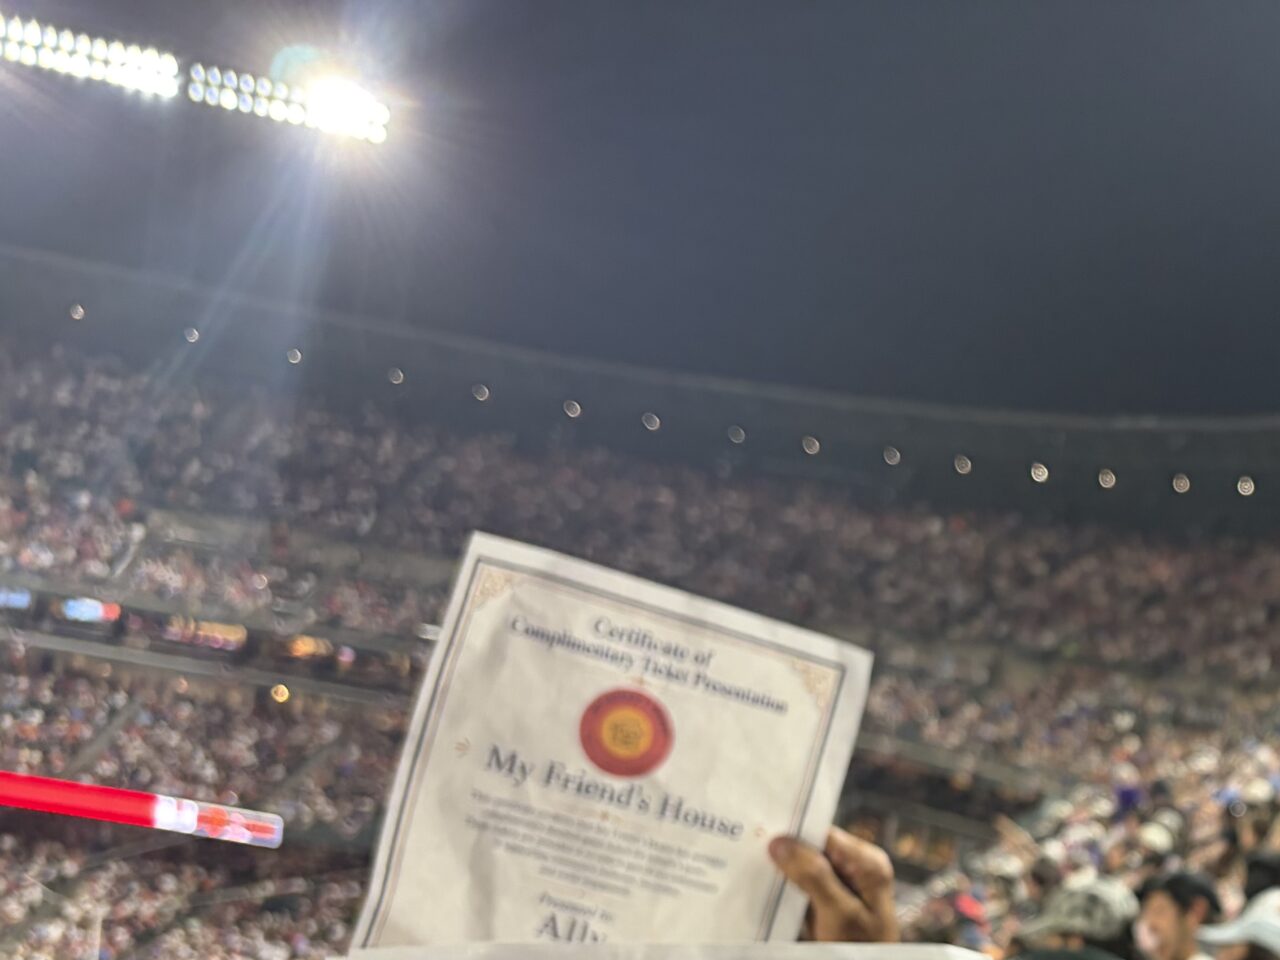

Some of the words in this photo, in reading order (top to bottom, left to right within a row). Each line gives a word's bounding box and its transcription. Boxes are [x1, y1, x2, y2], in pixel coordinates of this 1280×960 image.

[594, 616, 690, 660] Certificate
[693, 648, 715, 667] of
[486, 744, 535, 787] My
[544, 758, 652, 812] Friend's
[657, 793, 745, 840] House
